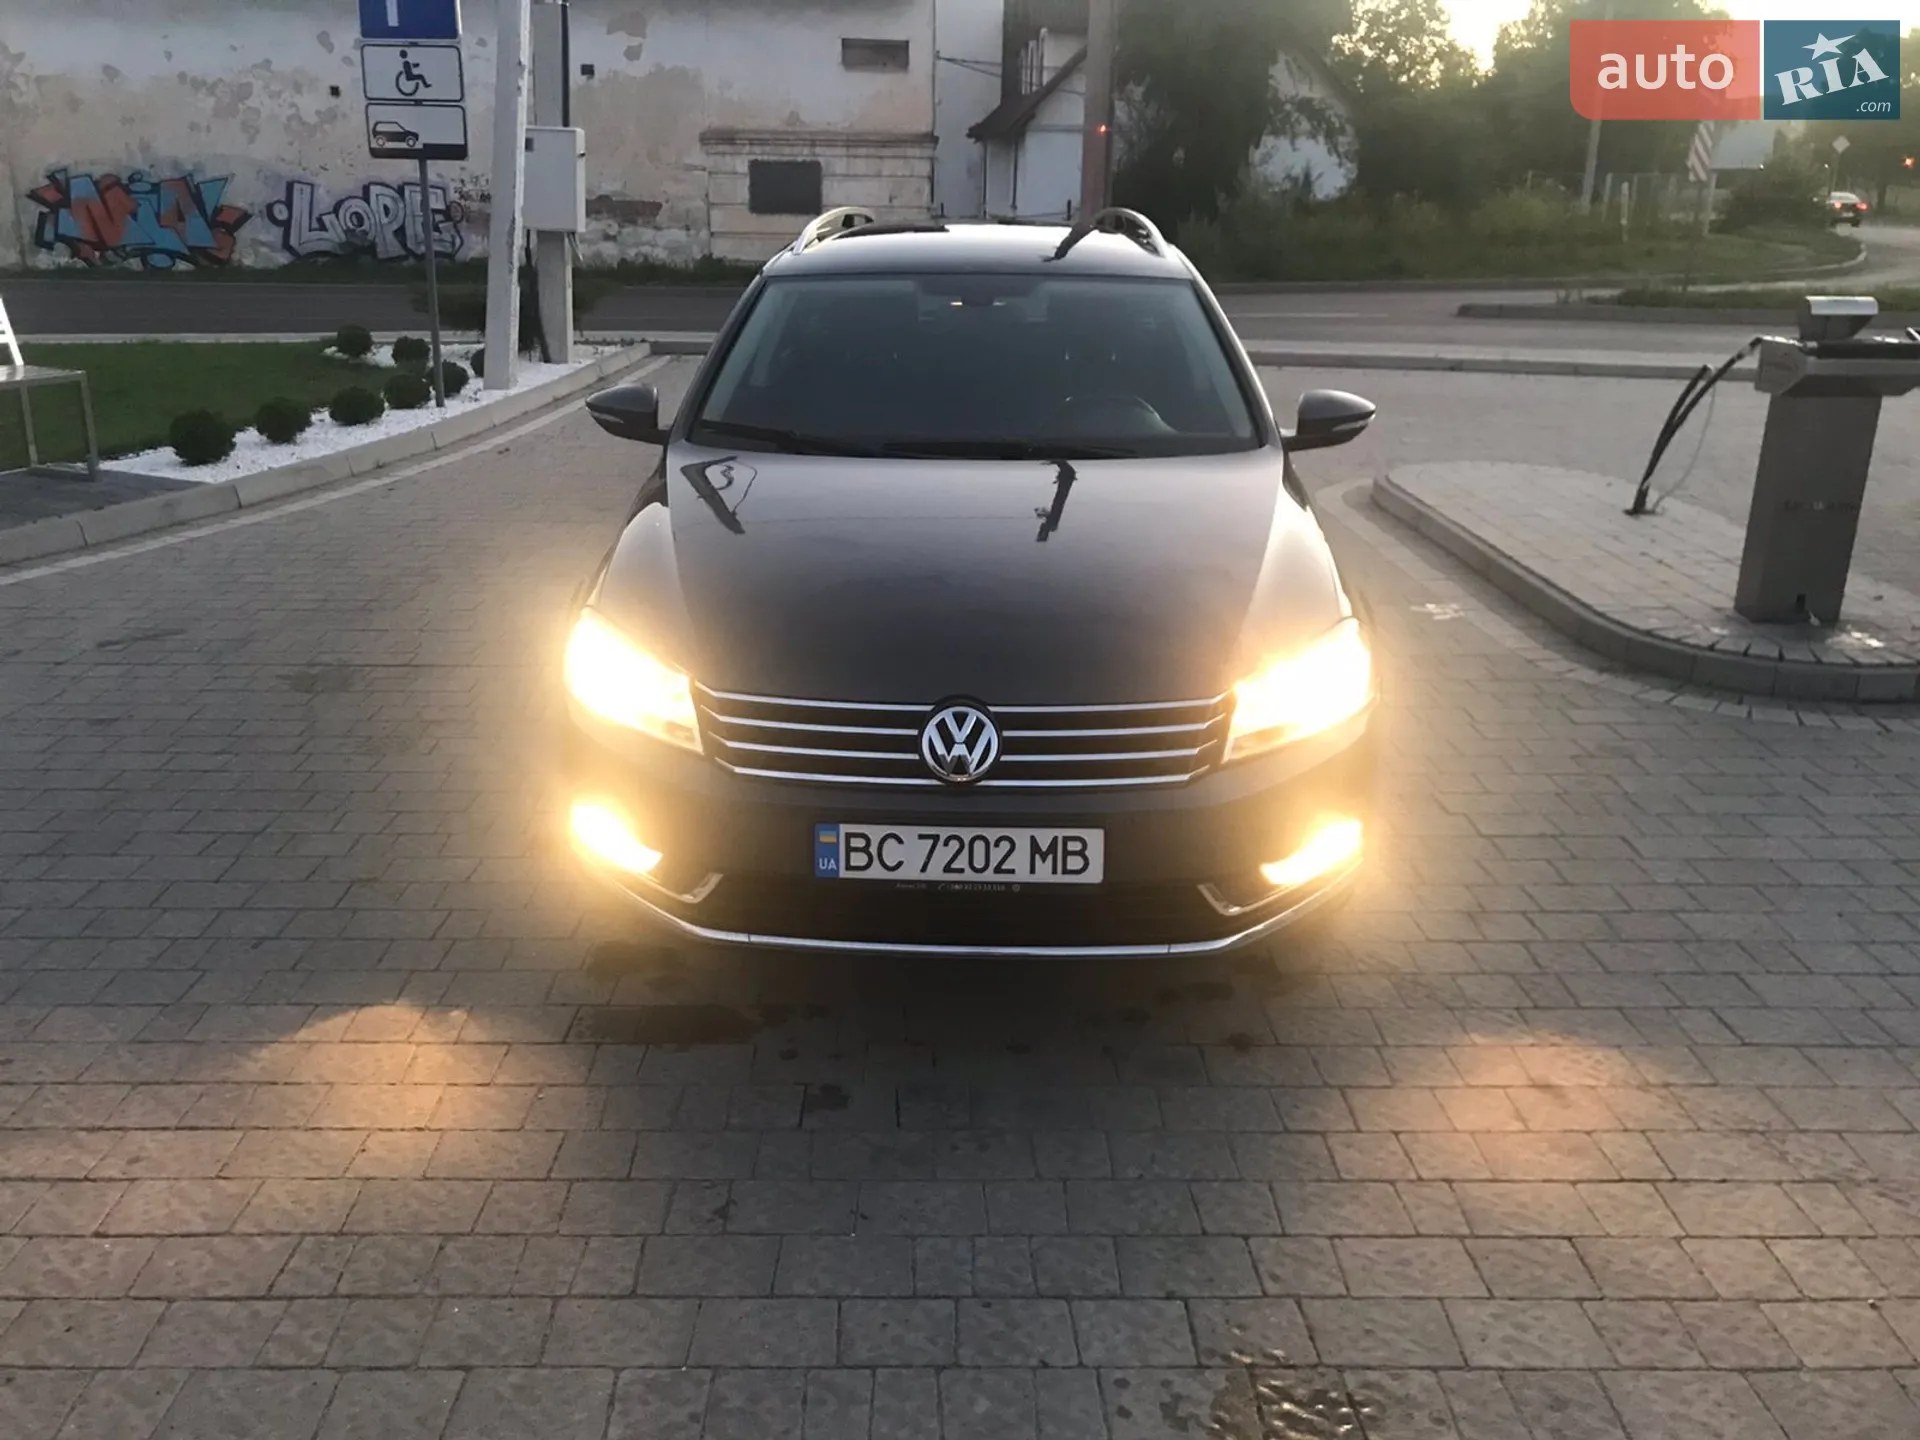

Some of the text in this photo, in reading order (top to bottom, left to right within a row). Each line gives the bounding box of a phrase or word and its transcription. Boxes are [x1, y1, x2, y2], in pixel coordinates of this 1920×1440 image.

[922, 706, 998, 781] VW
[818, 858, 837, 871] UA
[844, 832, 1090, 875] BC 7202 MB
